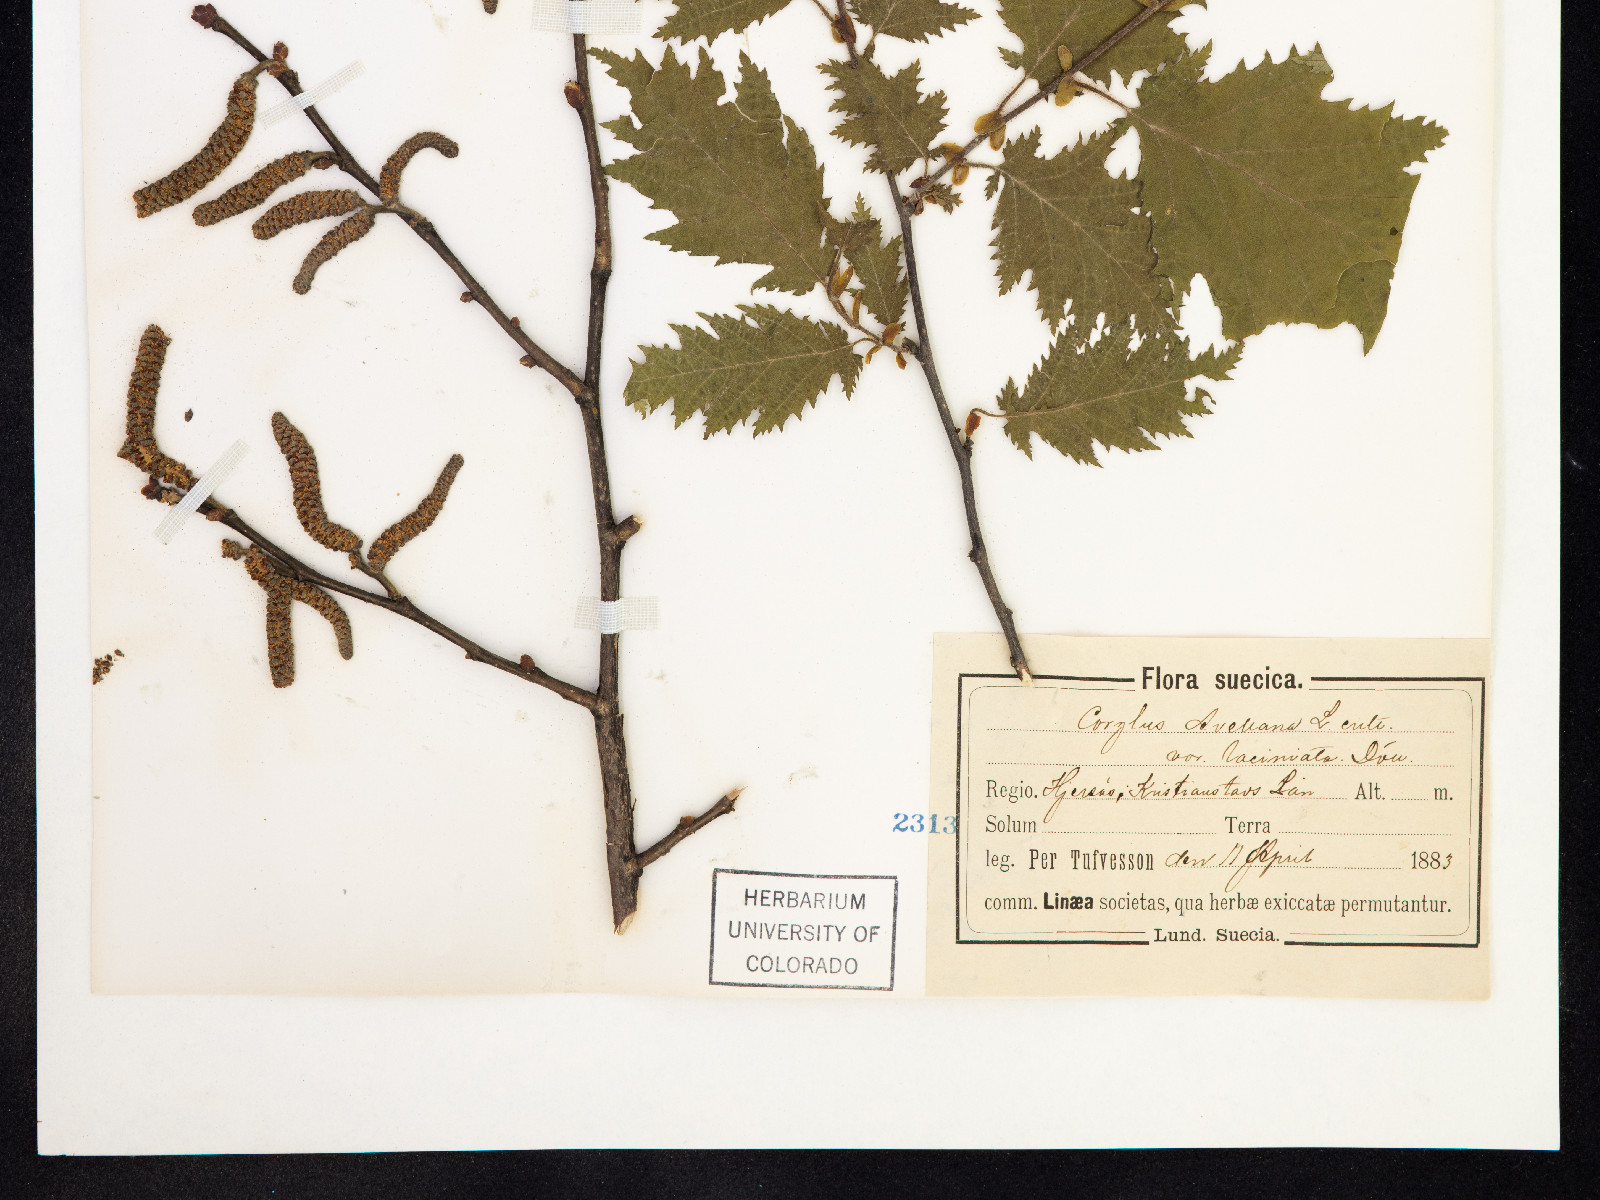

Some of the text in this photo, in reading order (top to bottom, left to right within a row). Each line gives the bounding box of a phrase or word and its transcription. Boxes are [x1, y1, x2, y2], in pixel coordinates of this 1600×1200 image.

[1142, 666, 1303, 690] Flora suecica.
[1078, 703, 1165, 754] Corylus
[1184, 708, 1302, 733] Avellana
[986, 780, 1038, 803] Regio.
[1355, 783, 1385, 801] Alt.
[1434, 786, 1453, 801] m.
[893, 813, 957, 834] 2313
[986, 815, 1271, 834] Solum Terra
[986, 850, 1014, 872] leg.
[1029, 849, 1057, 870] Per
[1071, 849, 1154, 871] Tufvesson
[744, 888, 866, 909] HERBARIUM
[985, 893, 1451, 917] comm. Linæa societas, qua herbæ exiccatæ permutantur.
[728, 920, 880, 943] UNIVERSITY OF
[1154, 928, 1280, 942] Lund. Suecia.
[746, 955, 858, 975] COLORADO
